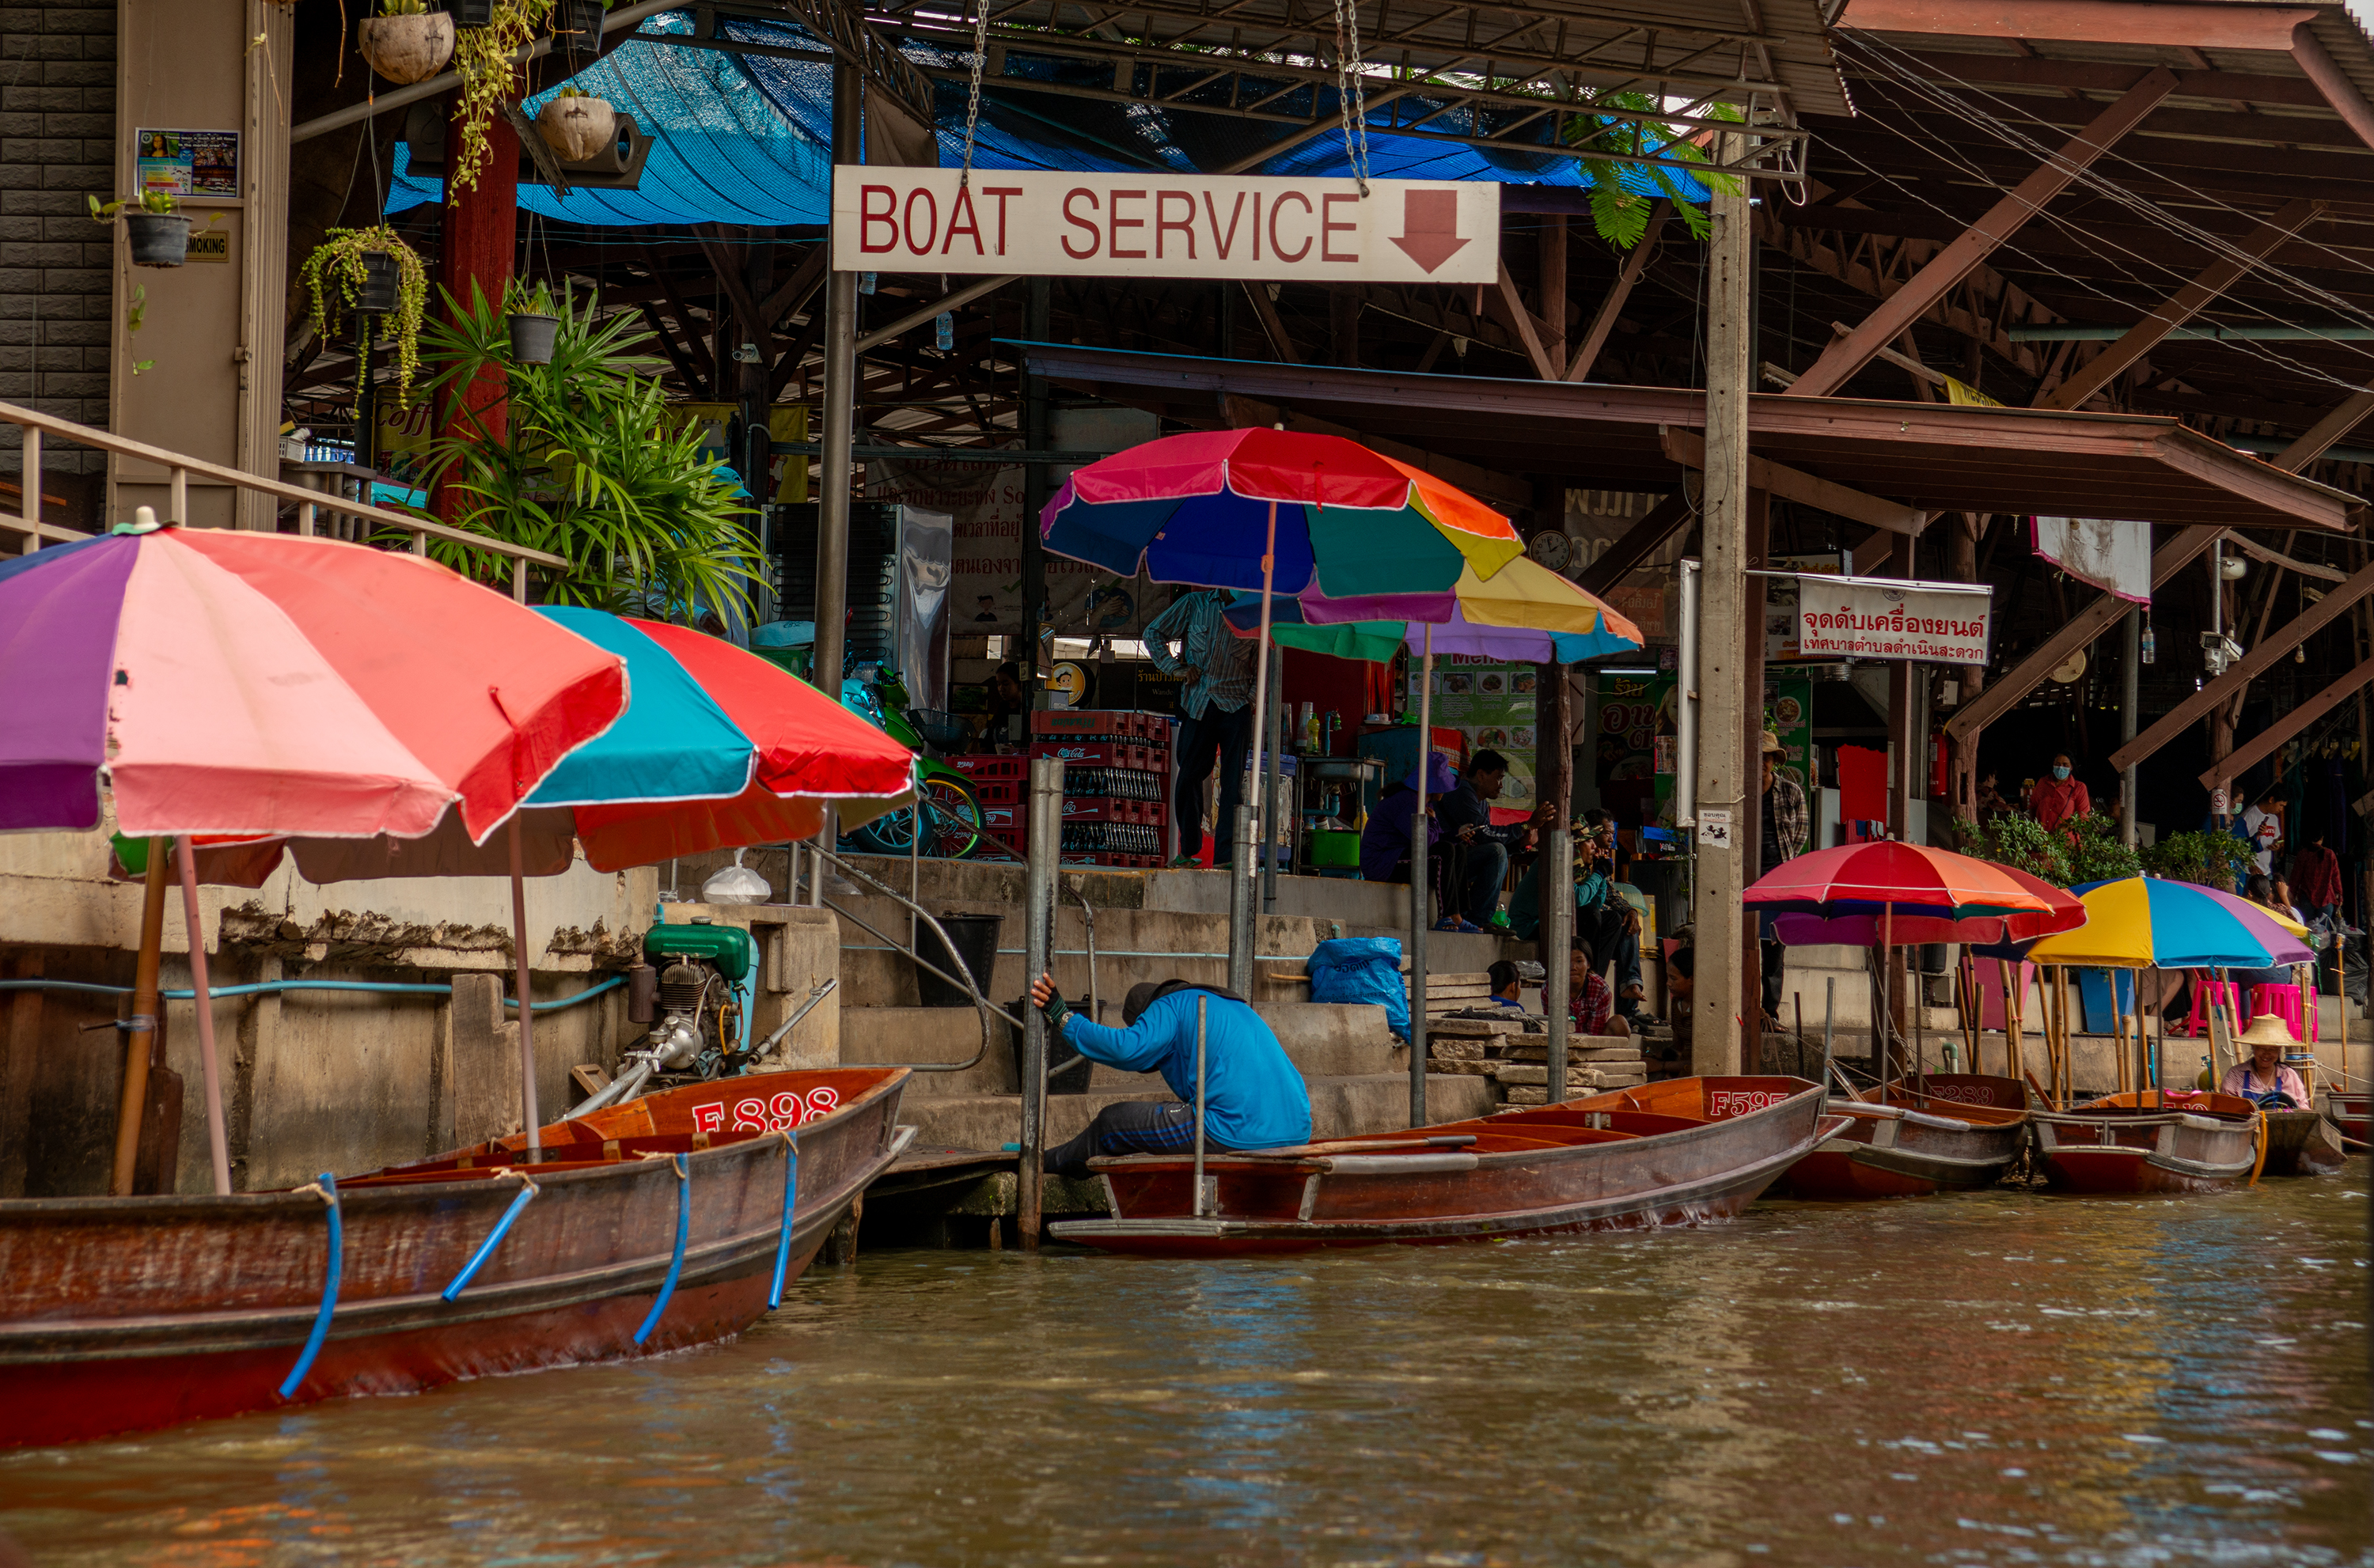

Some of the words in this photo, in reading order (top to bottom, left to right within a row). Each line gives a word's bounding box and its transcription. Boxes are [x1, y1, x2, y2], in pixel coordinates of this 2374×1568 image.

[859, 184, 1023, 256] BOAT
[1060, 187, 1360, 263] SERVICE
[1803, 604, 1986, 638] จุดดับเครื่องยนต์
[1804, 636, 1983, 660] เทศบาลตำบลดำเนินสะดวก
[1614, 677, 1644, 697] ร้าน
[692, 1102, 725, 1133] F
[732, 1087, 839, 1133] 898
[1929, 1085, 1994, 1106] F289
